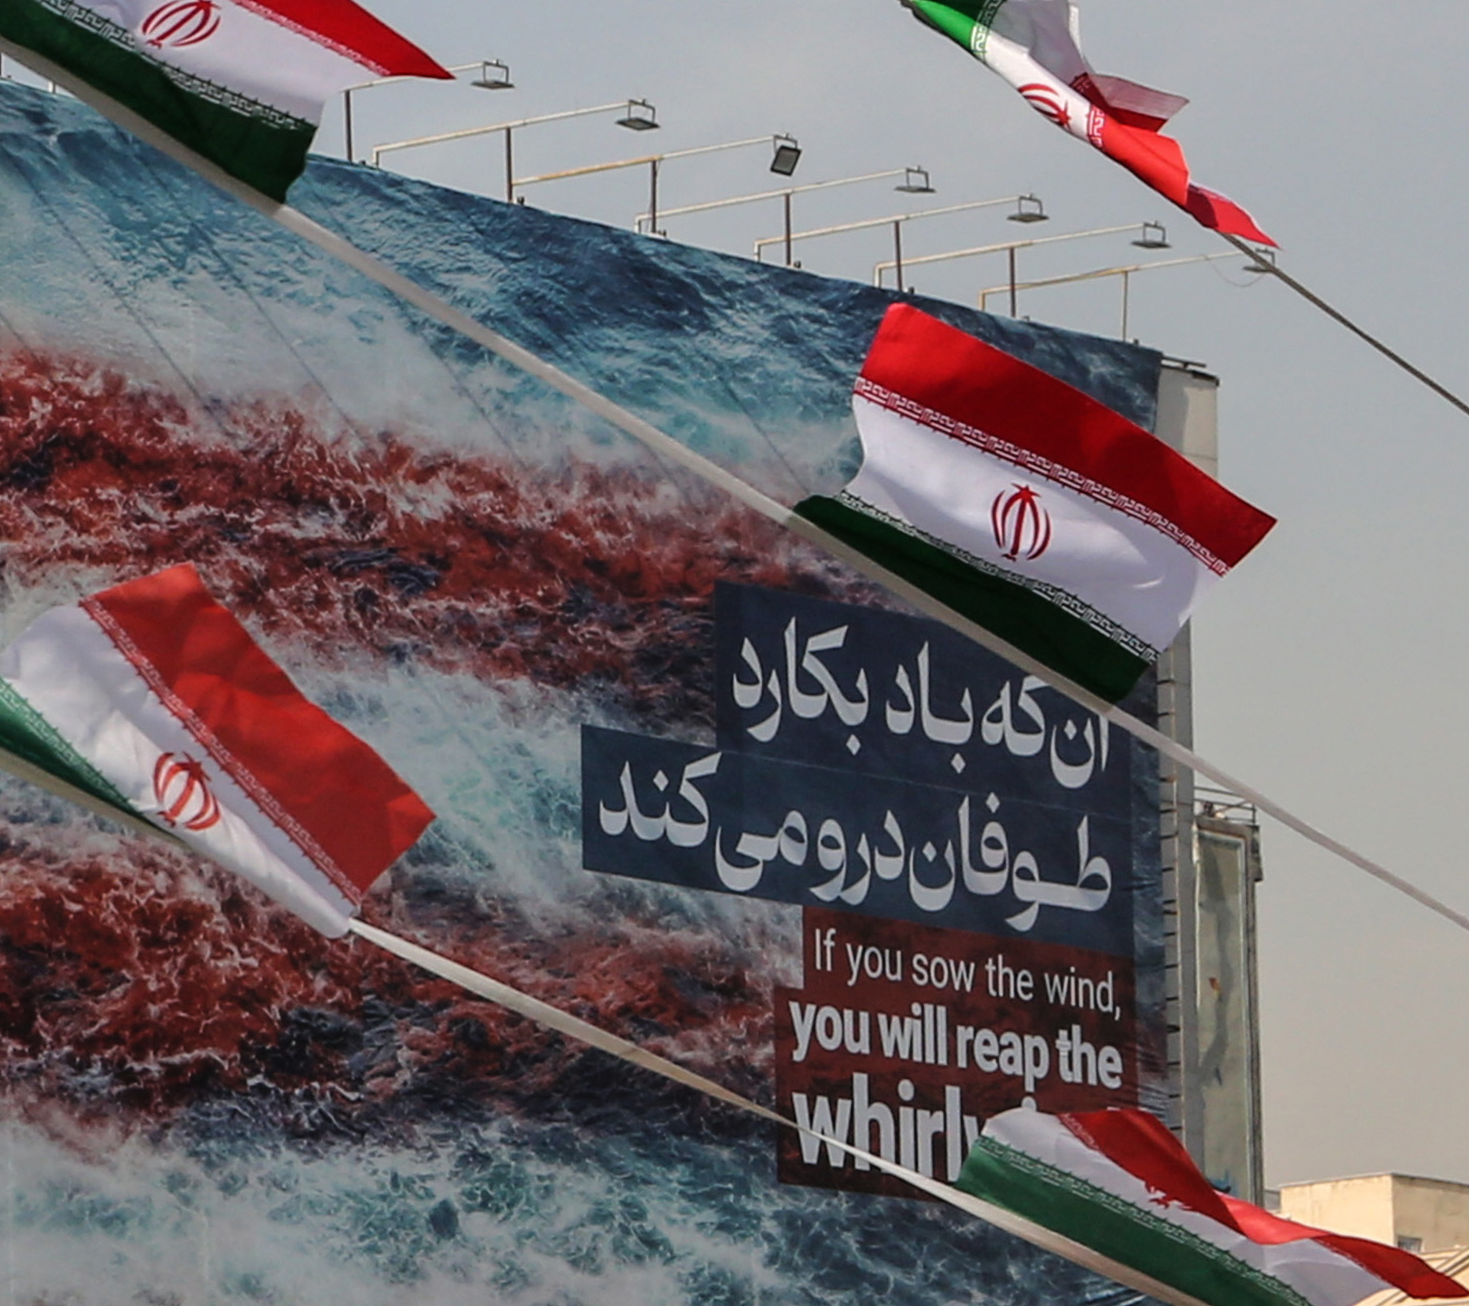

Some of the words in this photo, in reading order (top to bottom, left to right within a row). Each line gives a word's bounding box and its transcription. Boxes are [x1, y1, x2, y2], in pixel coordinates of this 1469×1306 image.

[733, 617, 870, 755] بکارد
[885, 641, 974, 774] باد
[909, 792, 1112, 932] طوفان
[815, 928, 836, 971] If
[846, 942, 903, 986] you
[911, 953, 975, 993] sow
[985, 954, 1034, 1001] the
[1043, 966, 1121, 1021] wind,
[789, 1000, 871, 1062] you
[878, 1003, 948, 1066] will
[957, 1024, 1050, 1092] reap
[1055, 1024, 1124, 1089] the
